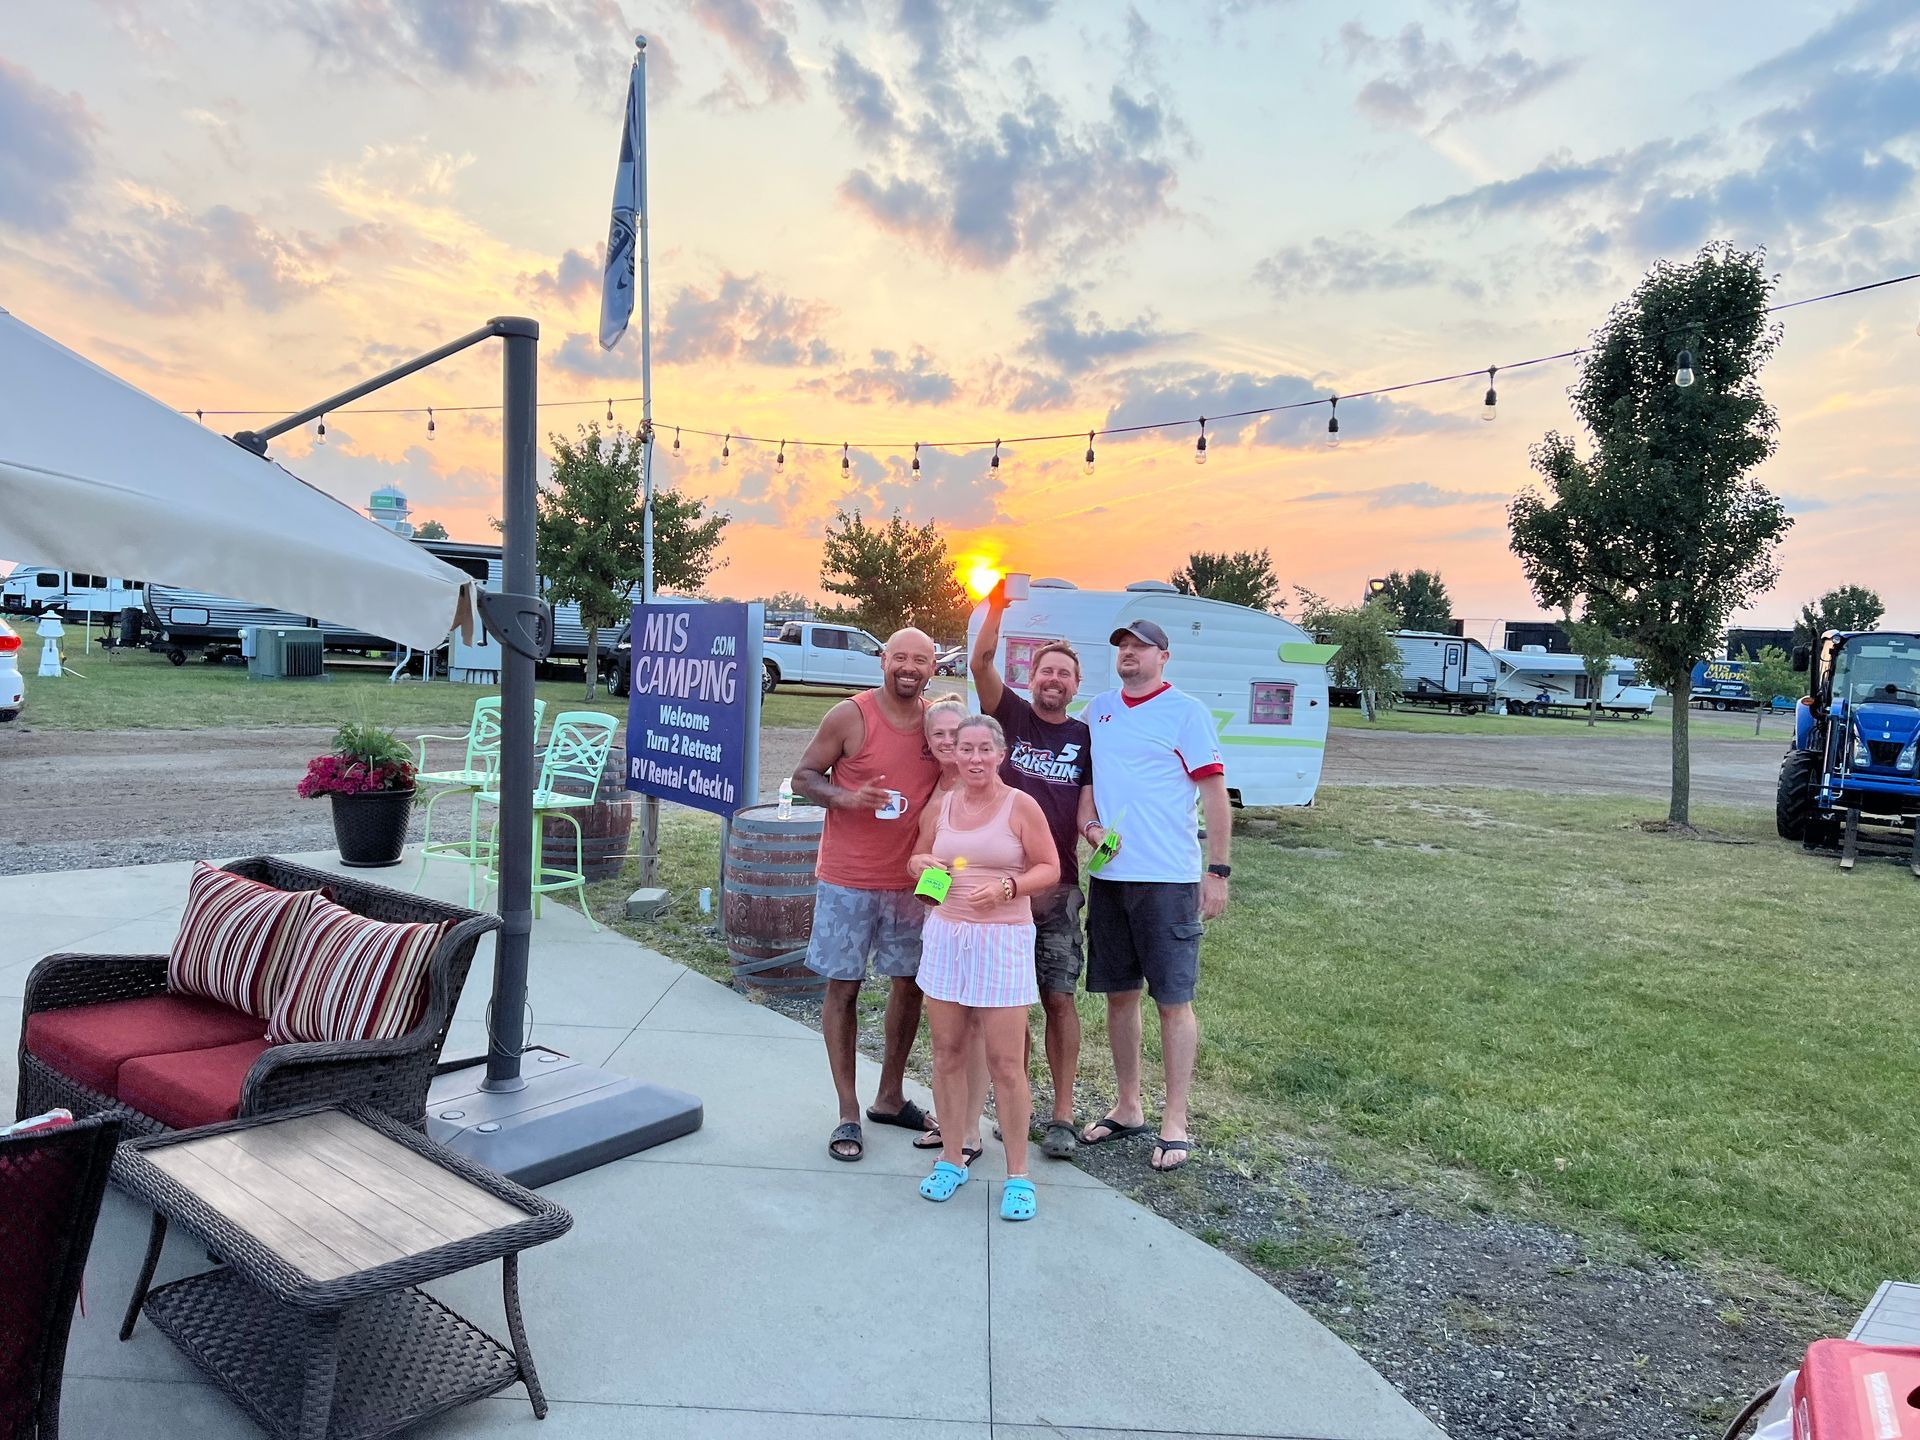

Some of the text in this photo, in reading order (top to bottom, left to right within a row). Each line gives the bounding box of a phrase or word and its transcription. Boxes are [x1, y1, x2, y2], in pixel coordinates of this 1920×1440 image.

[643, 613, 689, 653] MIS
[635, 656, 737, 704] CAMPING
[1710, 664, 1730, 673] MIS
[660, 705, 710, 732] Welcome
[646, 730, 722, 763] Turn 2 Retreat
[1056, 743, 1082, 762] 5
[631, 757, 649, 780] RV
[648, 760, 684, 789] Rental
[688, 769, 723, 800] Check
[722, 777, 734, 804] In
